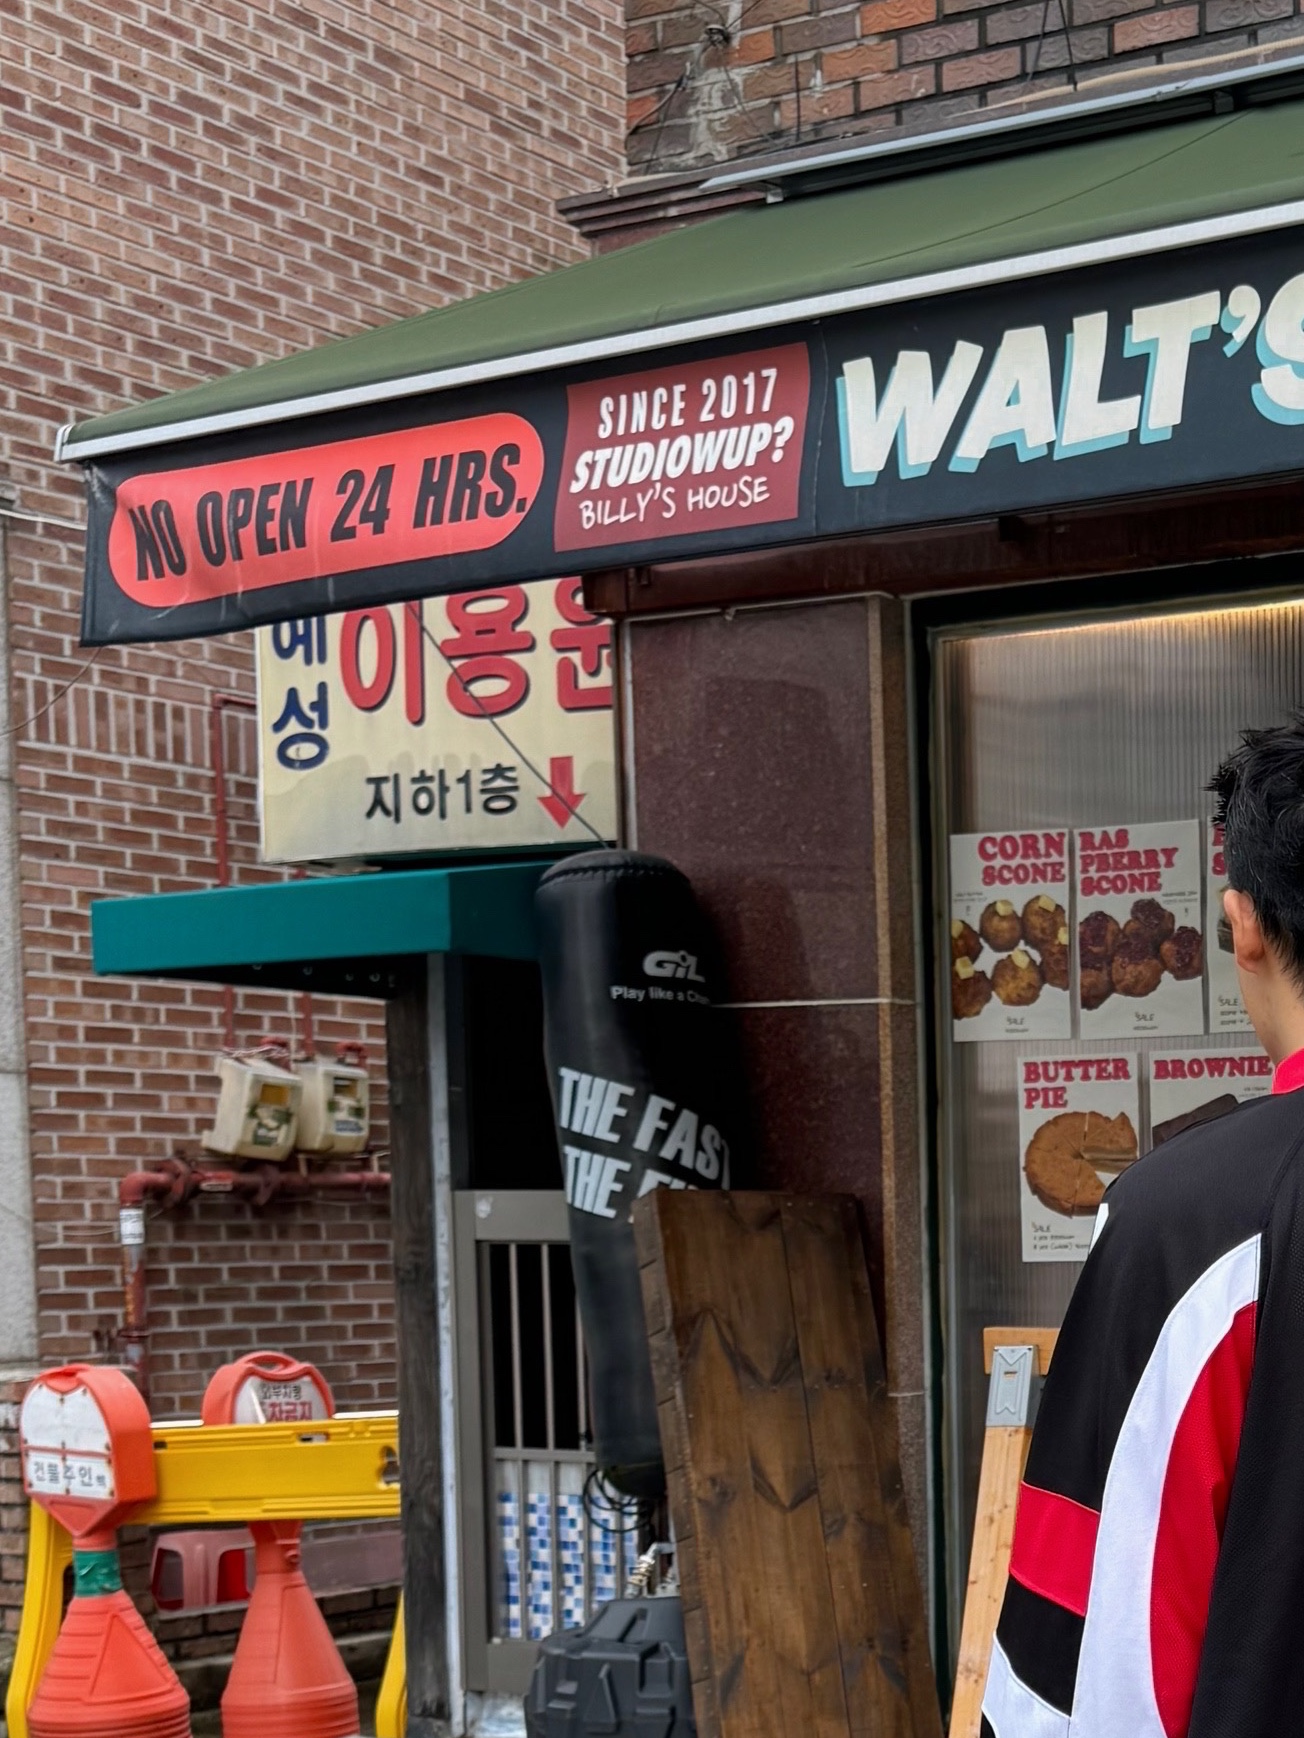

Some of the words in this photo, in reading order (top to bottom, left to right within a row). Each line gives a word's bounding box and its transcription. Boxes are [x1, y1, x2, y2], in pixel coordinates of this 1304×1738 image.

[597, 384, 687, 439] SINCE
[699, 368, 778, 422] 2017
[571, 415, 795, 494] STUDIOWUP?
[127, 499, 188, 582] NO
[196, 477, 315, 568] OPEN
[330, 464, 396, 543] 24
[412, 442, 528, 529] HRS.
[580, 482, 677, 530] BILLY'S
[687, 475, 771, 512] HOUSE
[365, 763, 521, 824] 지하1층
[978, 832, 1066, 862] CORN
[1079, 828, 1130, 853] RAS
[981, 861, 1067, 887] SCONE
[1080, 847, 1179, 875] PBERRY
[1080, 871, 1162, 897] SCONE
[609, 985, 645, 1003] Play
[648, 986, 675, 1001] like
[1023, 1058, 1130, 1084] BUTTER
[1153, 1056, 1273, 1080] BROWNIE
[558, 1067, 636, 1143] THE
[1024, 1087, 1069, 1110] PIE
[562, 1145, 632, 1219] THE
[262, 1401, 313, 1421] 차금지
